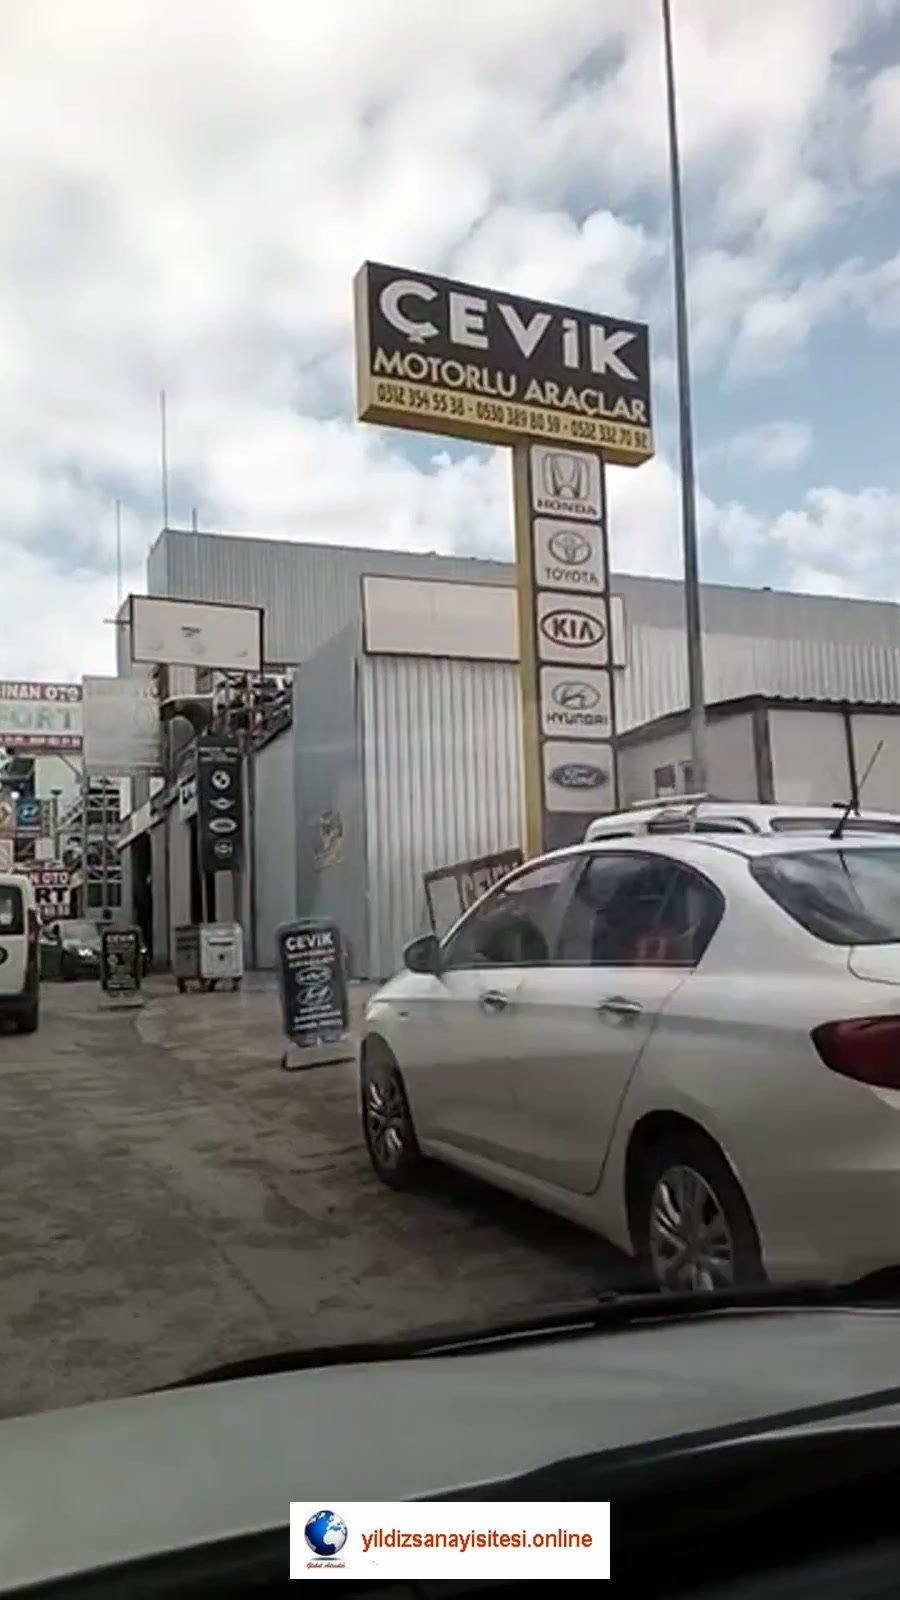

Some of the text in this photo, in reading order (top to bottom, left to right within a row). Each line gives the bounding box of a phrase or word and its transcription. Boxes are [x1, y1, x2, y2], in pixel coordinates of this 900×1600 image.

[374, 347, 648, 423] MOTORLU ARAÇLAR
[536, 497, 598, 517] HONDA
[545, 566, 600, 586] TOYOTA
[551, 617, 595, 642] KIA
[45, 686, 79, 702] OTO
[546, 712, 609, 727] HYUNDAI
[558, 765, 600, 786] Ford
